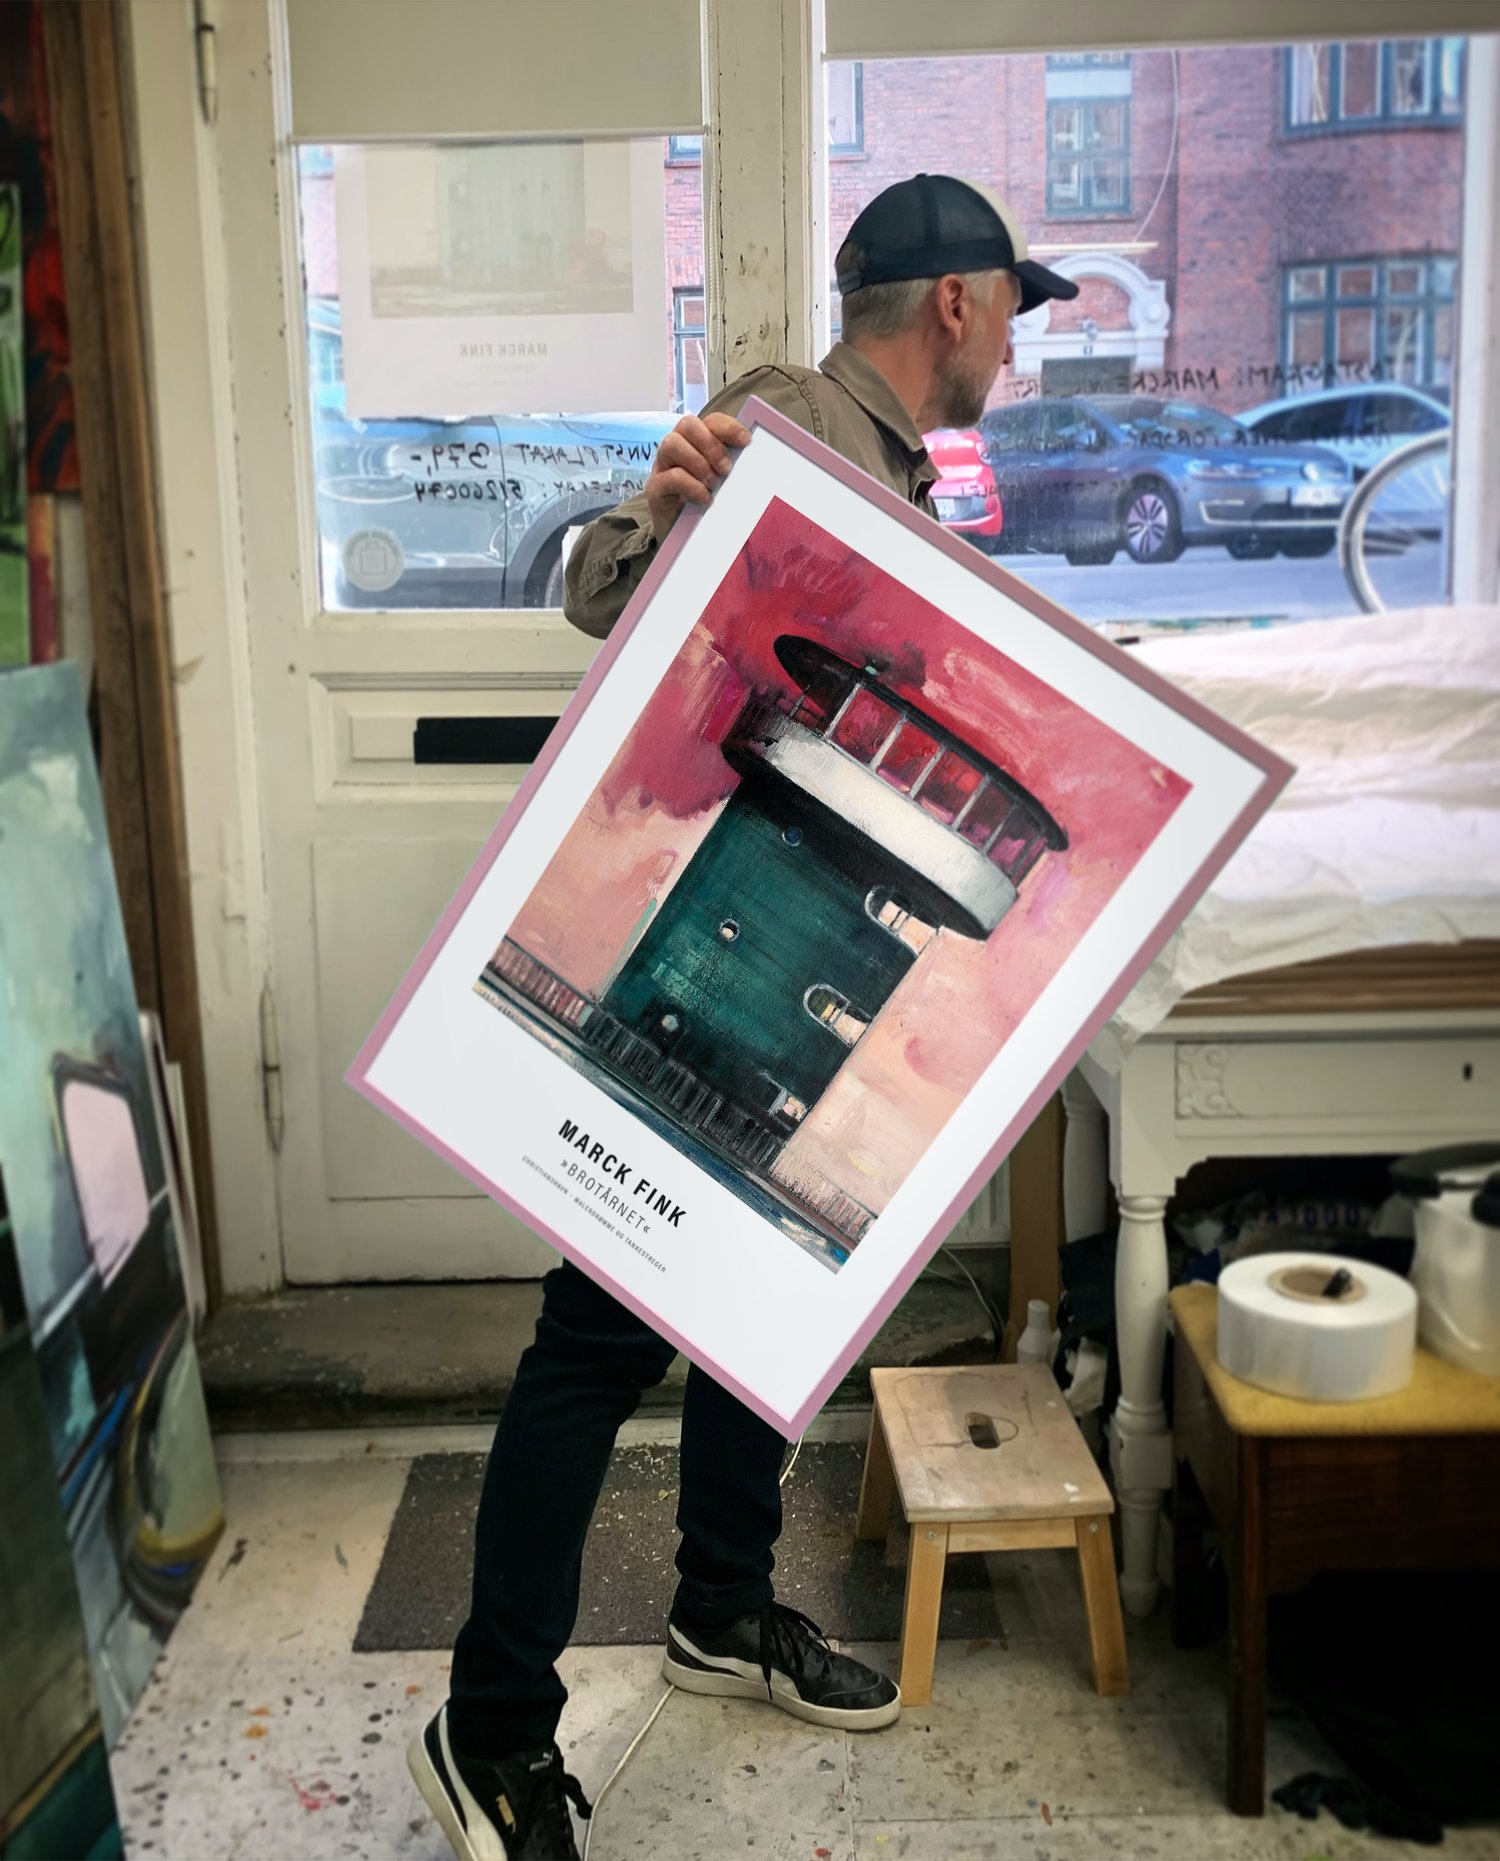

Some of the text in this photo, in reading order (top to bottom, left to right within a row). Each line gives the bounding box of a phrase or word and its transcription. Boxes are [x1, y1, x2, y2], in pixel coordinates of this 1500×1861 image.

[558, 1119, 687, 1228] MARCK FINK
[560, 1159, 651, 1234] »BROTÅRNET«
[615, 1230, 625, 1240] OG
